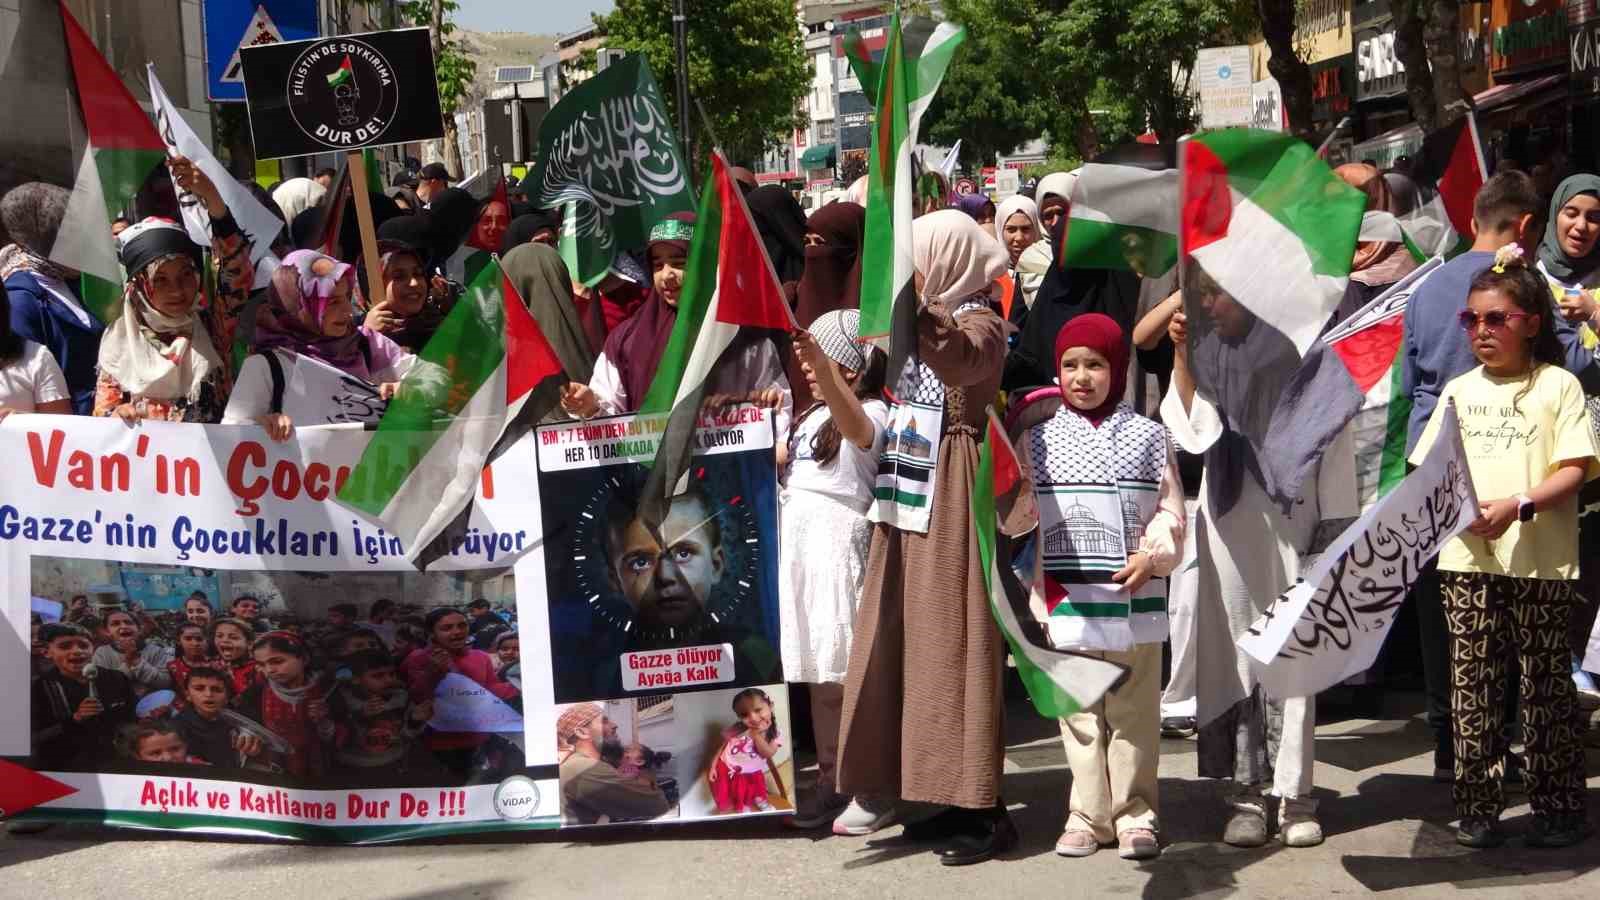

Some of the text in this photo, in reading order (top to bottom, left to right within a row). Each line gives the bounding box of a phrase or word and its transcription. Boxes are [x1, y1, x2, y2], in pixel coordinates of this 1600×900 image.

[340, 43, 392, 86] SOYKIRIMA
[315, 117, 386, 144] DUR DE!
[1467, 405, 1492, 416] YOU
[542, 430, 558, 445] BM
[566, 429, 573, 442] 7
[27, 428, 201, 496] Van'ın
[565, 447, 585, 463] HER
[588, 445, 600, 460] 10
[0, 505, 157, 548] Gazze'nin
[172, 515, 338, 561] Çocukları
[352, 519, 405, 564] İçin
[628, 647, 722, 670] Gazze ölüyor
[637, 665, 719, 687] Ayağa Kalk
[141, 780, 466, 820] Açlık ve Katliama Dur De !!!
